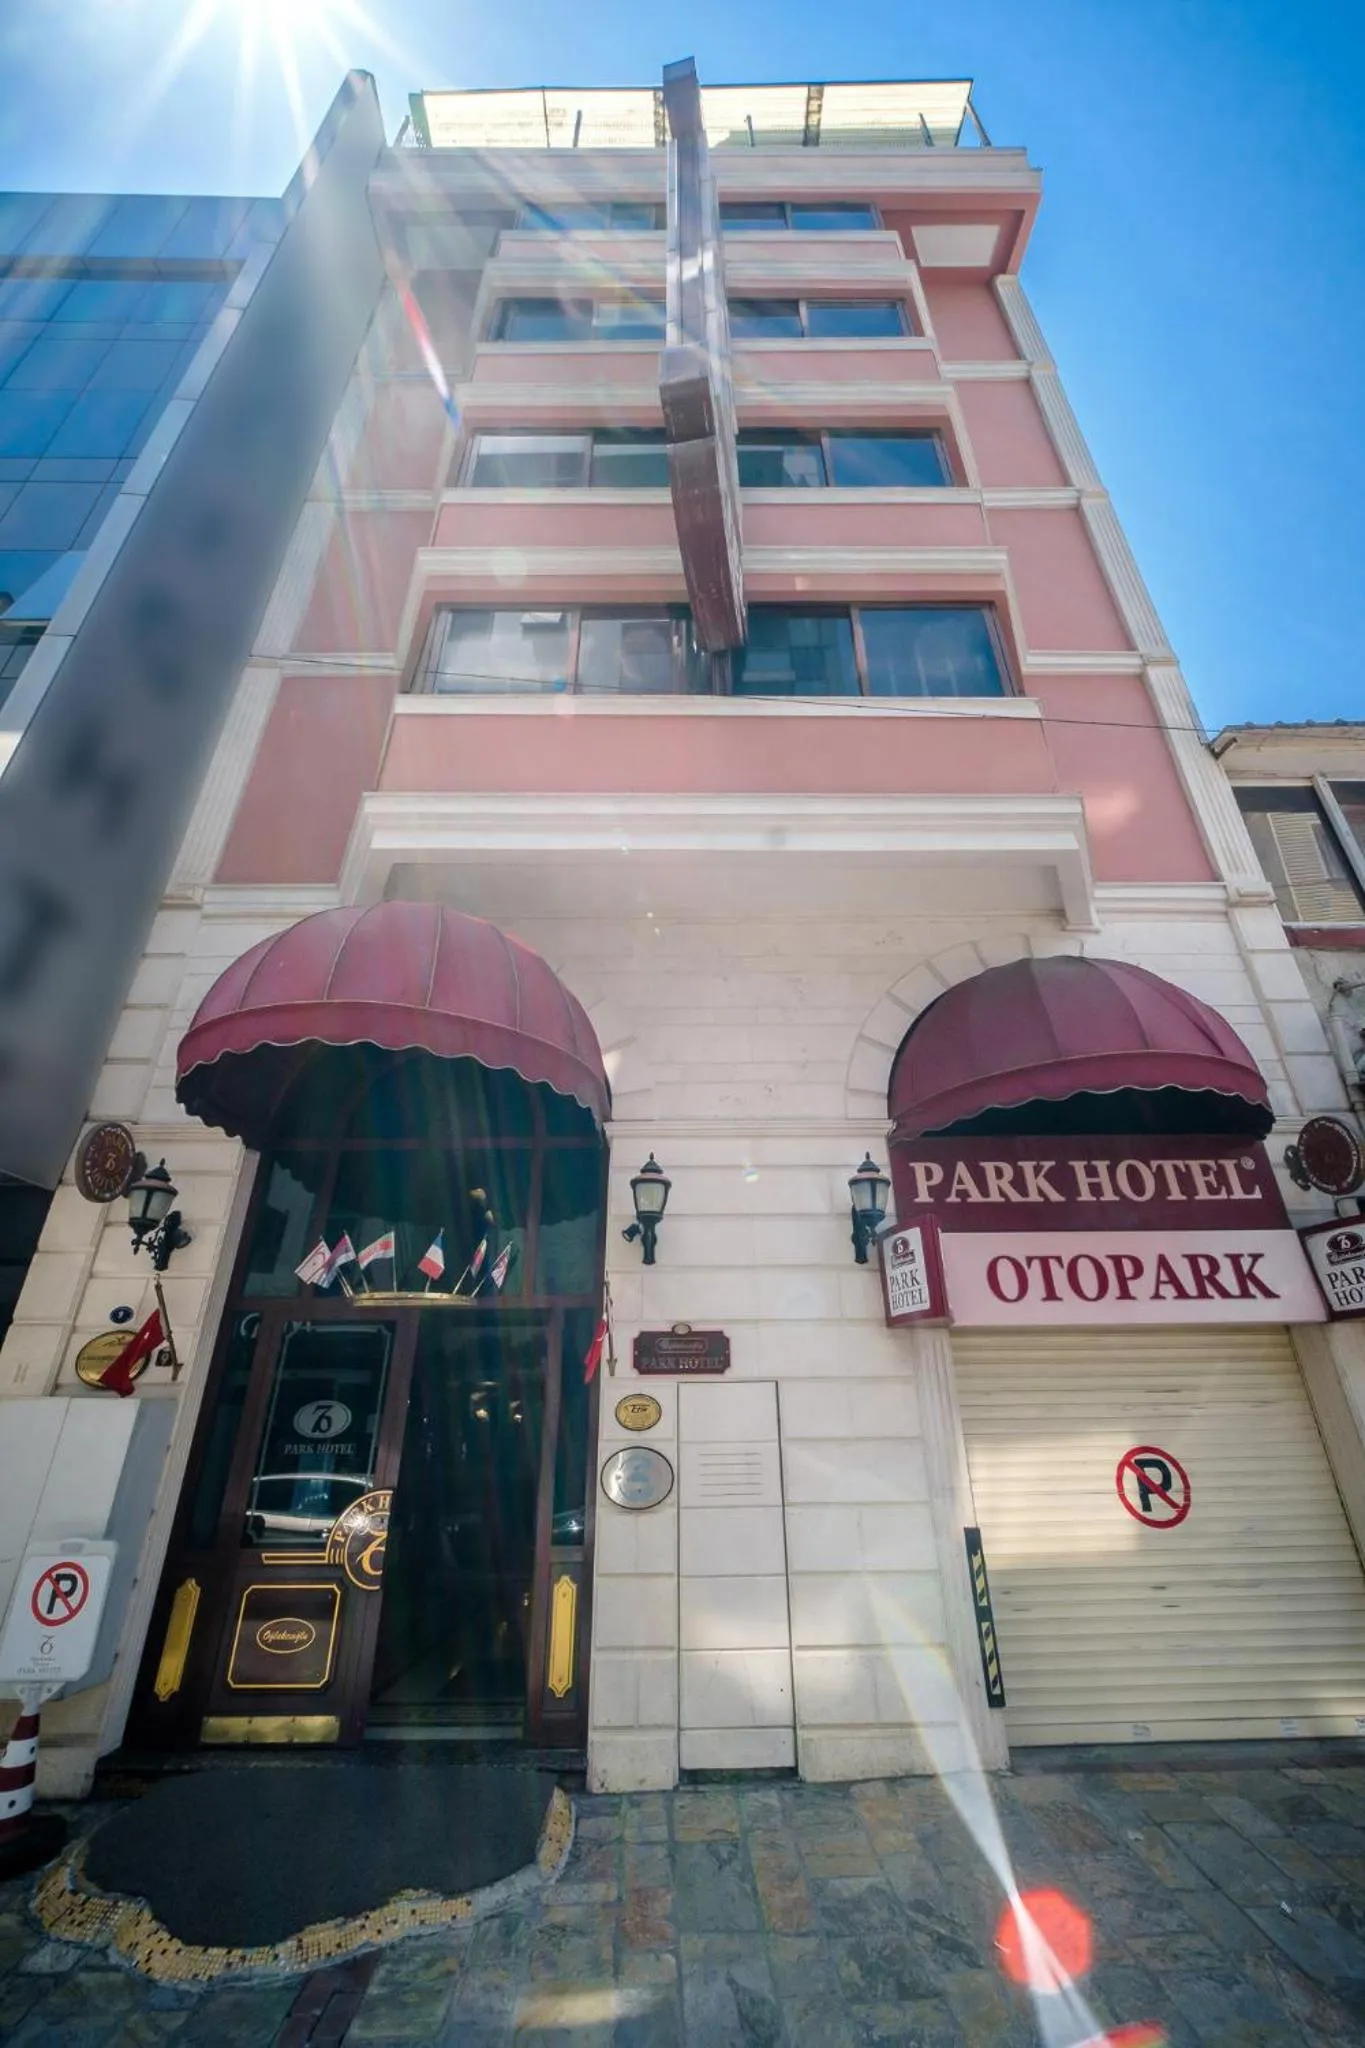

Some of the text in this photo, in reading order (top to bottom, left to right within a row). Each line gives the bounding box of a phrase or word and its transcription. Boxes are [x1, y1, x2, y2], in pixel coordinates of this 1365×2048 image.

[909, 1159, 1067, 1204] PARK
[889, 1268, 920, 1293] PARK
[986, 1252, 1281, 1304] OTOPARK
[1326, 1265, 1365, 1290] PAR
[892, 1288, 928, 1311] HOTEL
[1334, 1286, 1365, 1307] HO
[678, 1356, 724, 1370] HOTEL
[283, 1443, 354, 1455] PARK HOTEL
